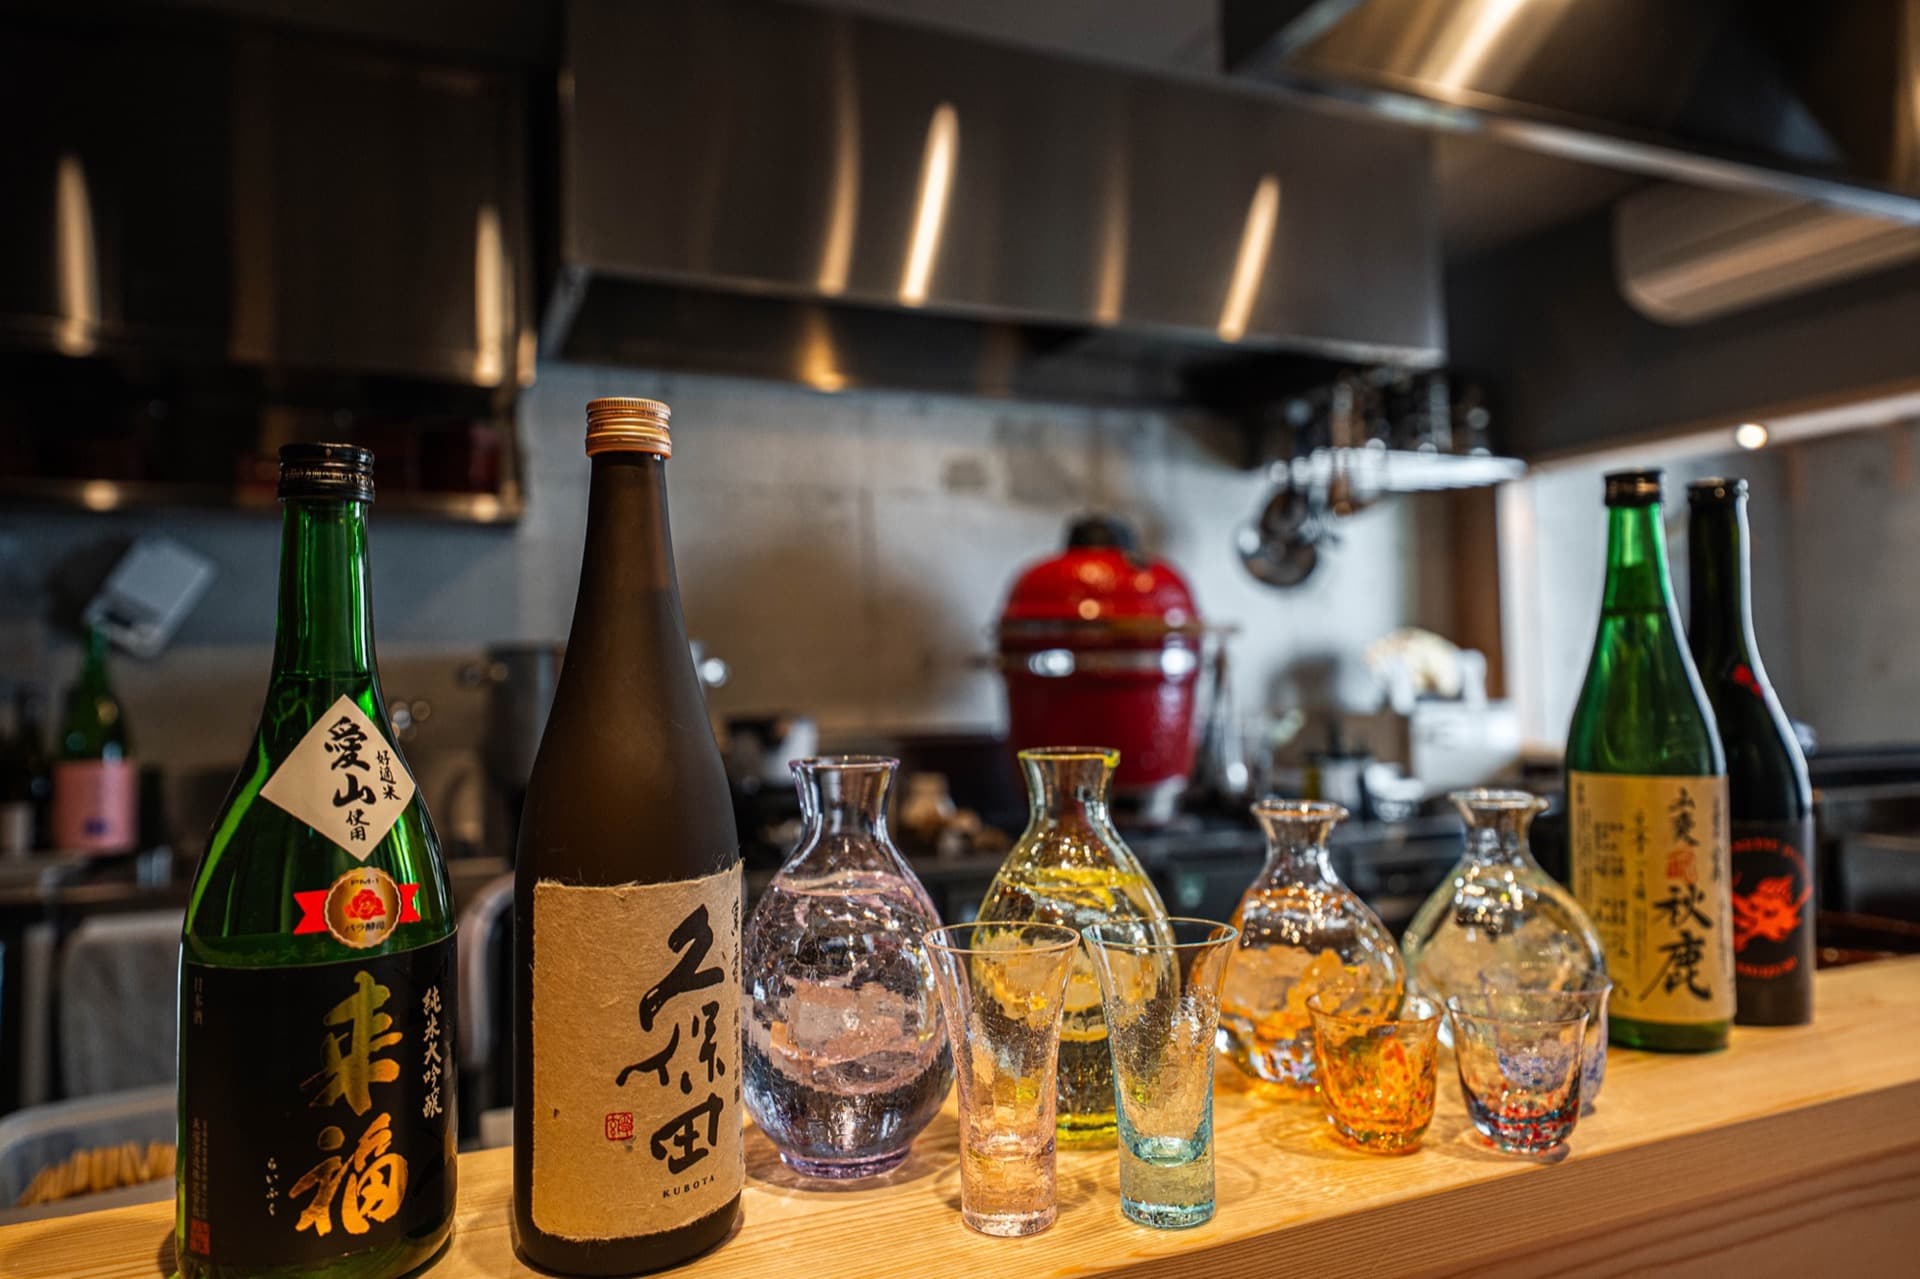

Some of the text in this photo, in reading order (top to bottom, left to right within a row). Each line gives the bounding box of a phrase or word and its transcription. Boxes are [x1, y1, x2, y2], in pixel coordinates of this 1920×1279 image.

[324, 716, 376, 807] 愛山
[422, 985, 442, 1119] 純米大吟醸
[616, 903, 725, 1175] 久保田
[289, 970, 409, 1236] 来福
[266, 1157, 278, 1216] らいふく
[662, 1174, 715, 1198] KUBOTA
